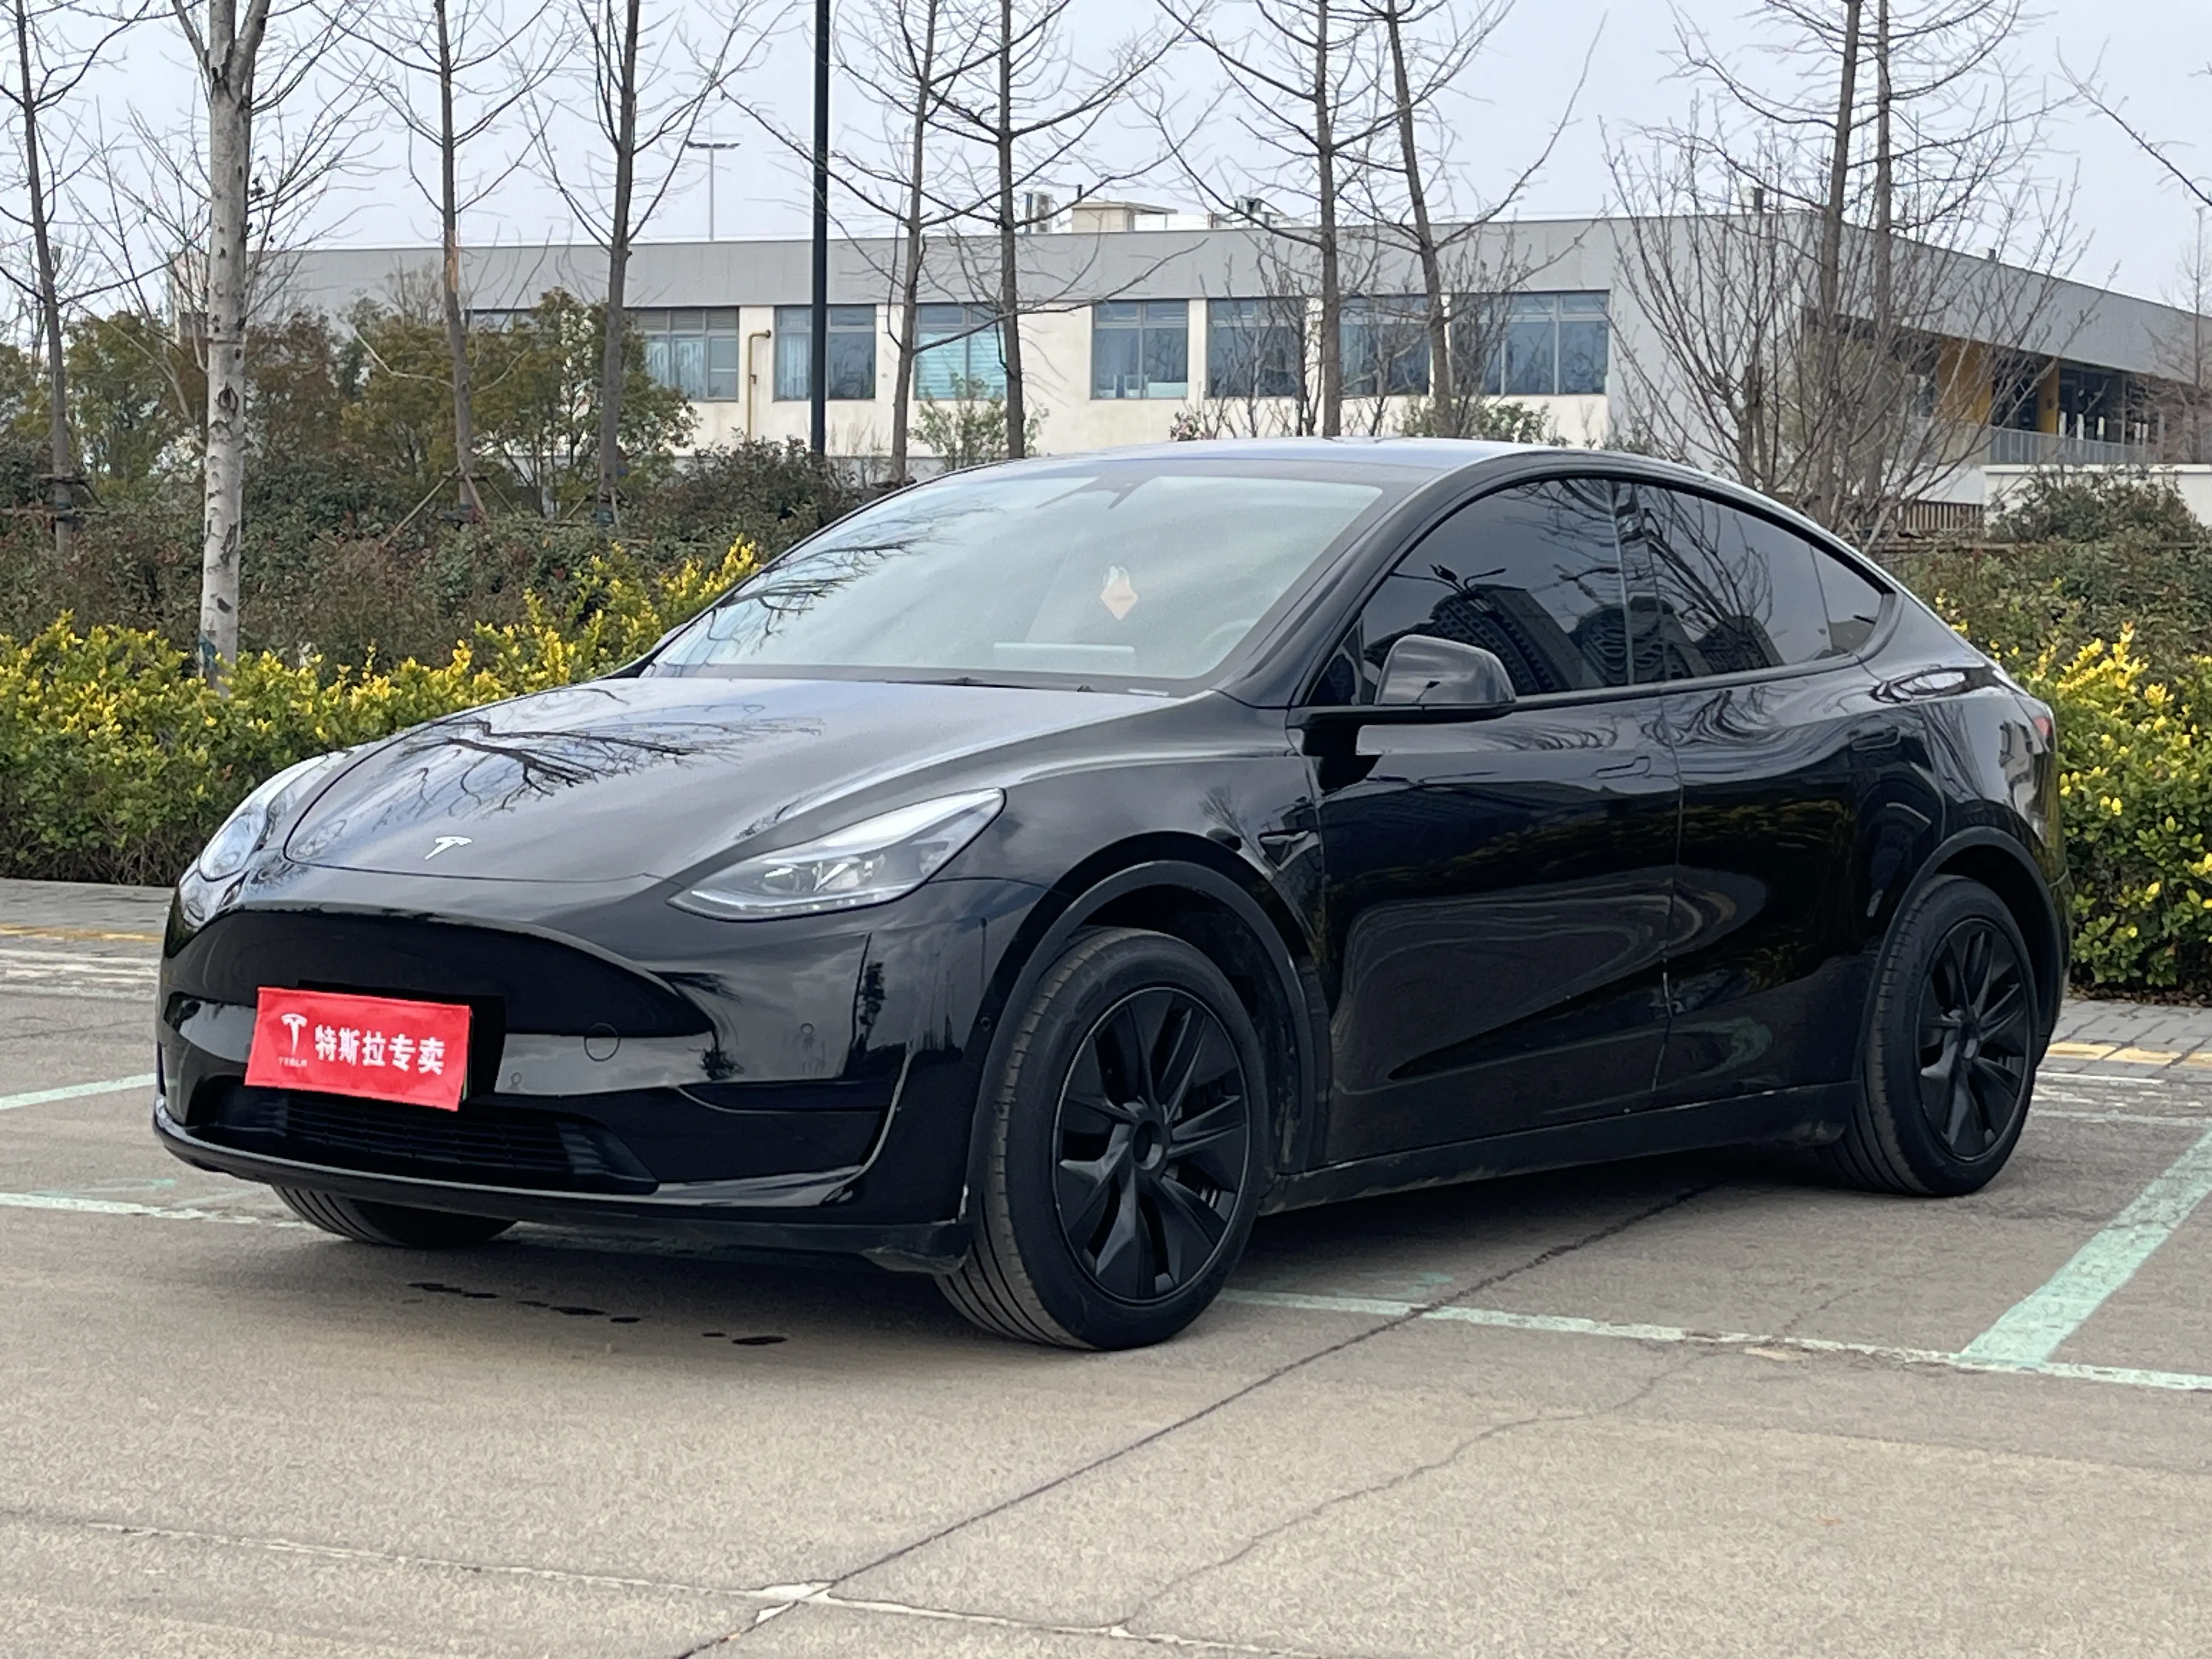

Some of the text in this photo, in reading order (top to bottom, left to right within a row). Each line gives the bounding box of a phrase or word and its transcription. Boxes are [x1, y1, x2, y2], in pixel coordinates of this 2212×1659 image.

[315, 1024, 445, 1075] 特斯拉专卖
